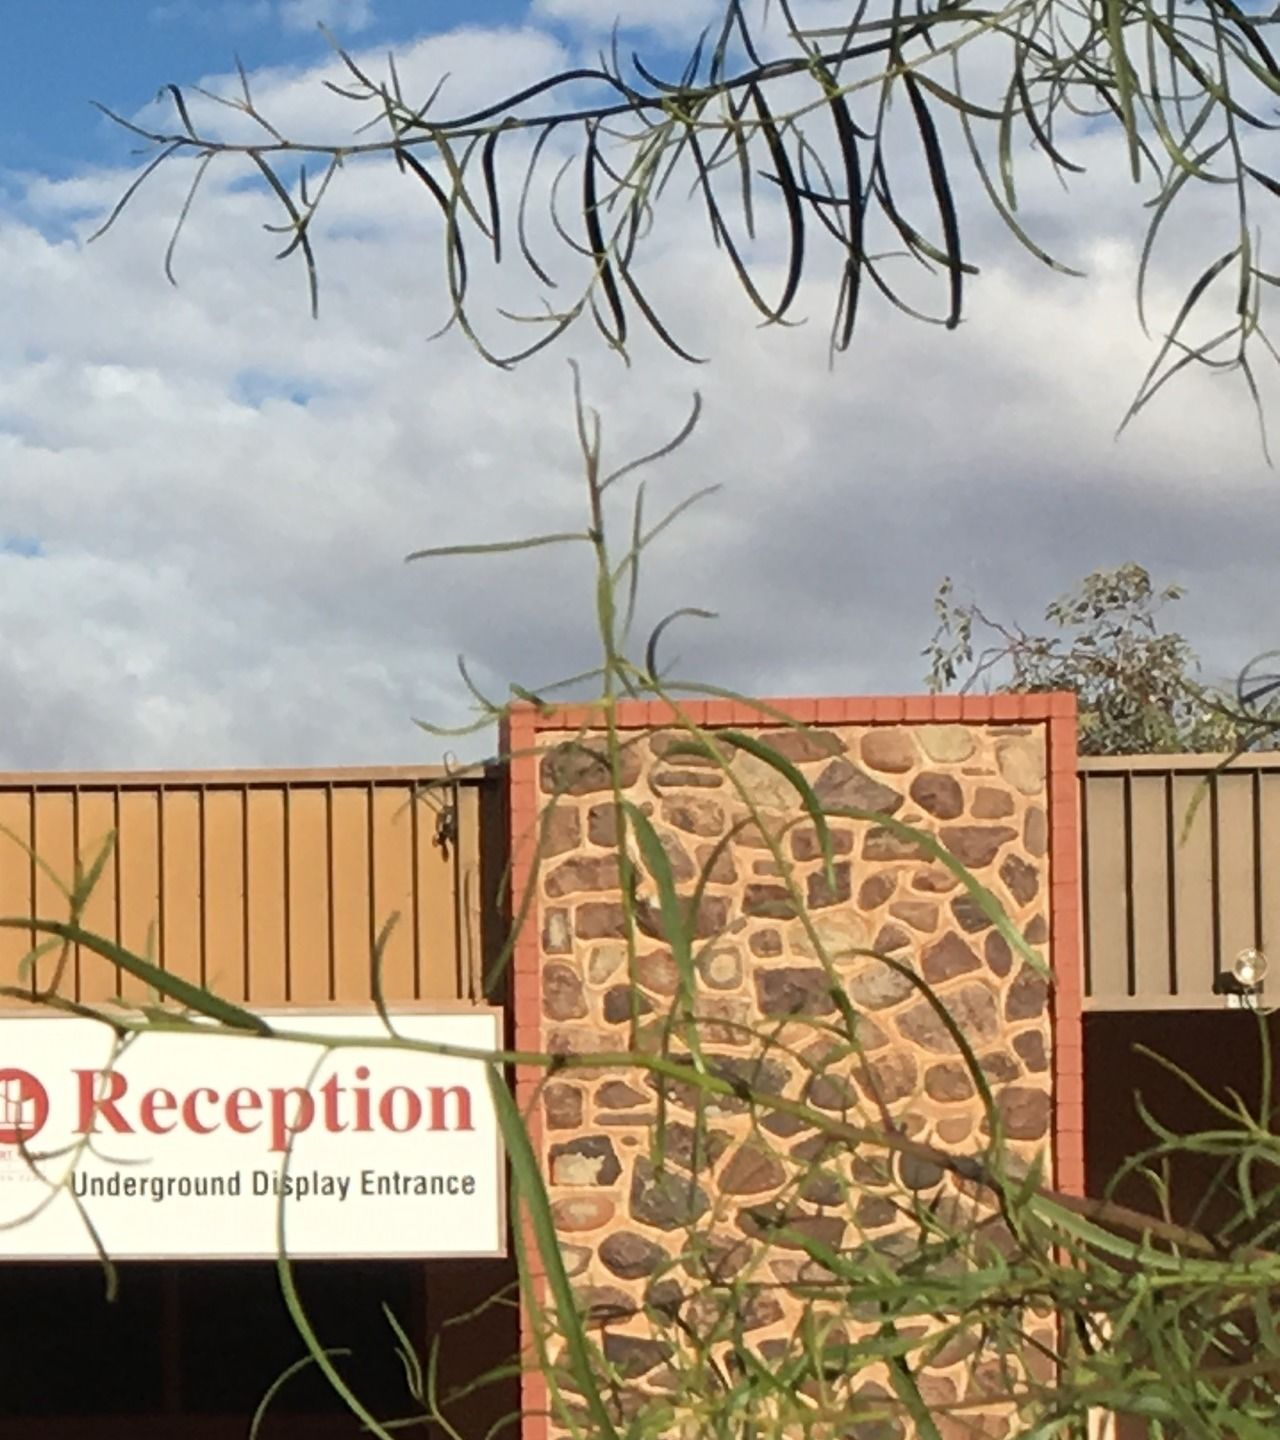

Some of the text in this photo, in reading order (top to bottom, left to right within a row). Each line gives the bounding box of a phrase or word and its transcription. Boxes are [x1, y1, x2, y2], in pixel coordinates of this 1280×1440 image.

[71, 1066, 476, 1152] Reception
[71, 1170, 476, 1202] Underground Display Entrance
